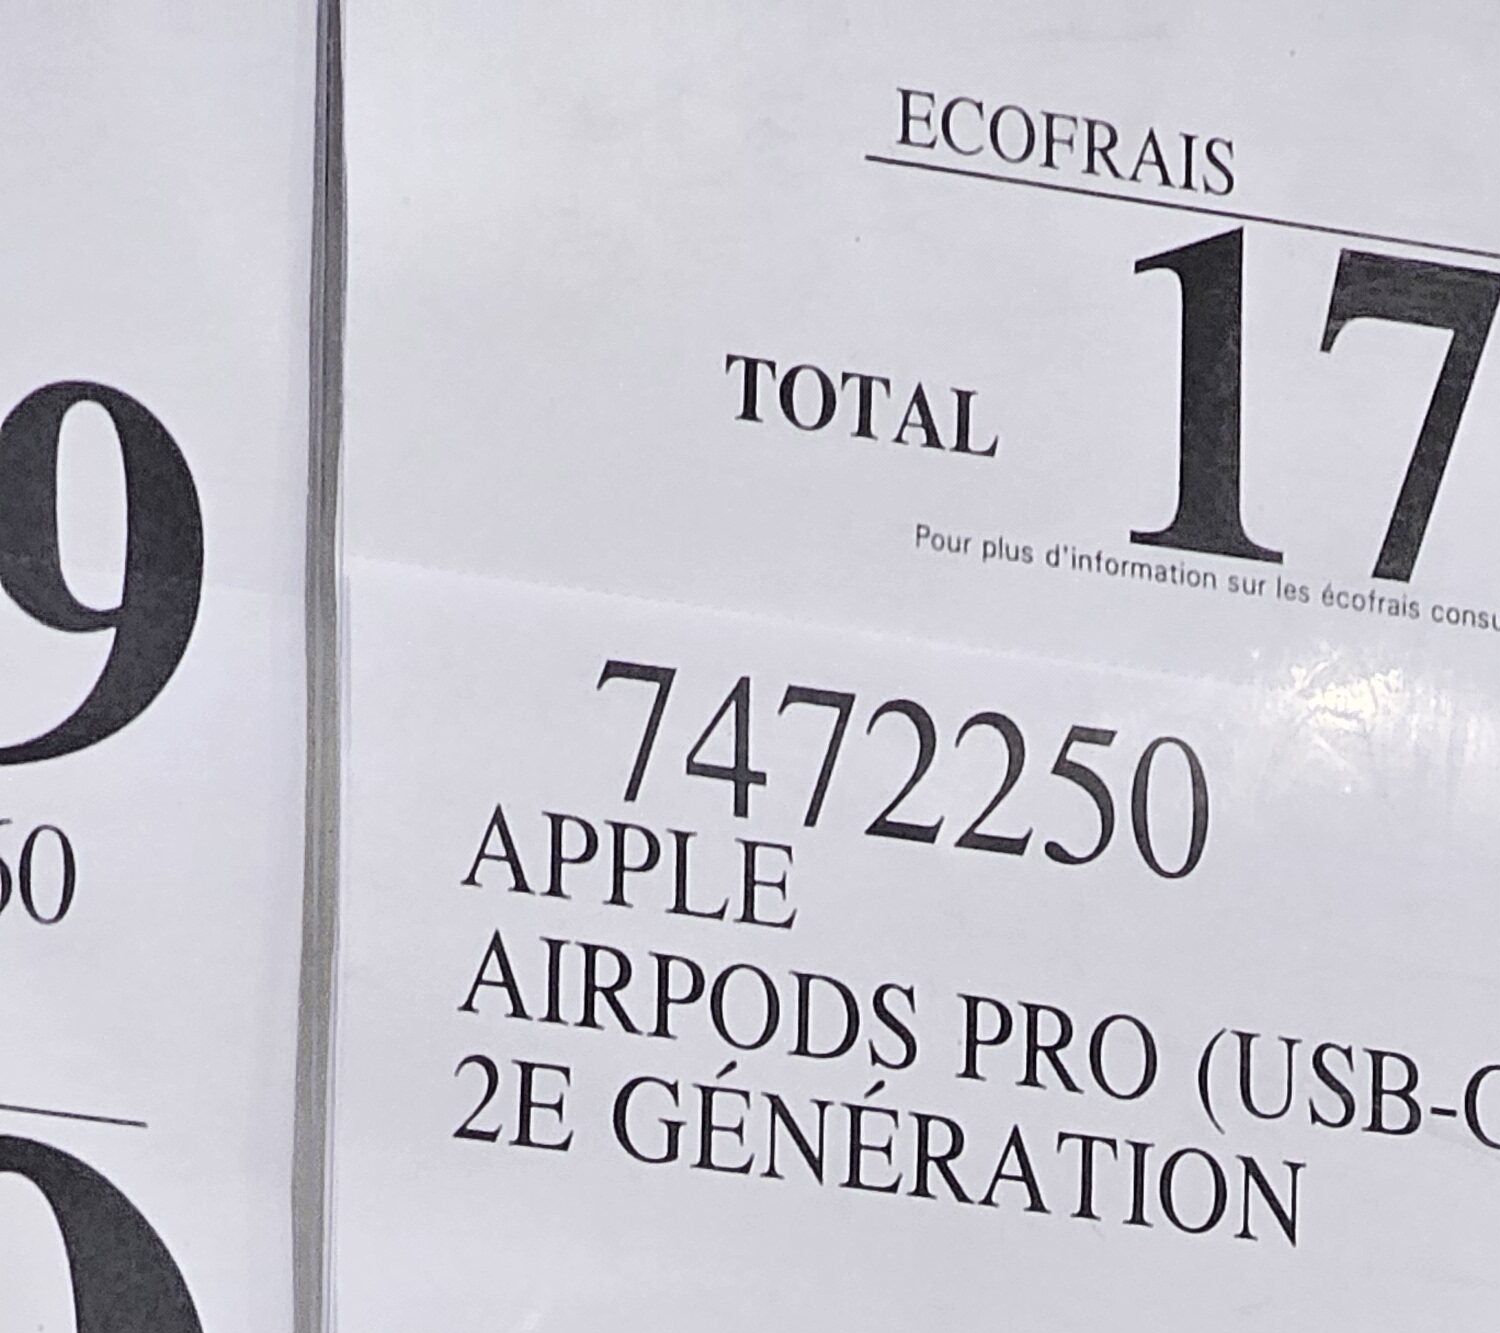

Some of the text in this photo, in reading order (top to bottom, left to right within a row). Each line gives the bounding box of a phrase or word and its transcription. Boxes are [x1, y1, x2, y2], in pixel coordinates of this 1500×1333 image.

[897, 88, 1236, 196] ECOFRAIS
[725, 353, 1000, 458] TOTAL
[915, 522, 973, 556] Pour
[981, 535, 1034, 566] plus
[1045, 543, 1217, 591] d'information
[1227, 574, 1266, 597] sur
[1276, 574, 1311, 604] les
[1321, 582, 1421, 620] écofrais
[596, 658, 1210, 880] 7472250
[460, 803, 798, 931] APPLE
[457, 929, 919, 1071] AIRPODS
[955, 993, 1159, 1102] PRO
[452, 1054, 1308, 1248] 2E GÉNÉRATION
